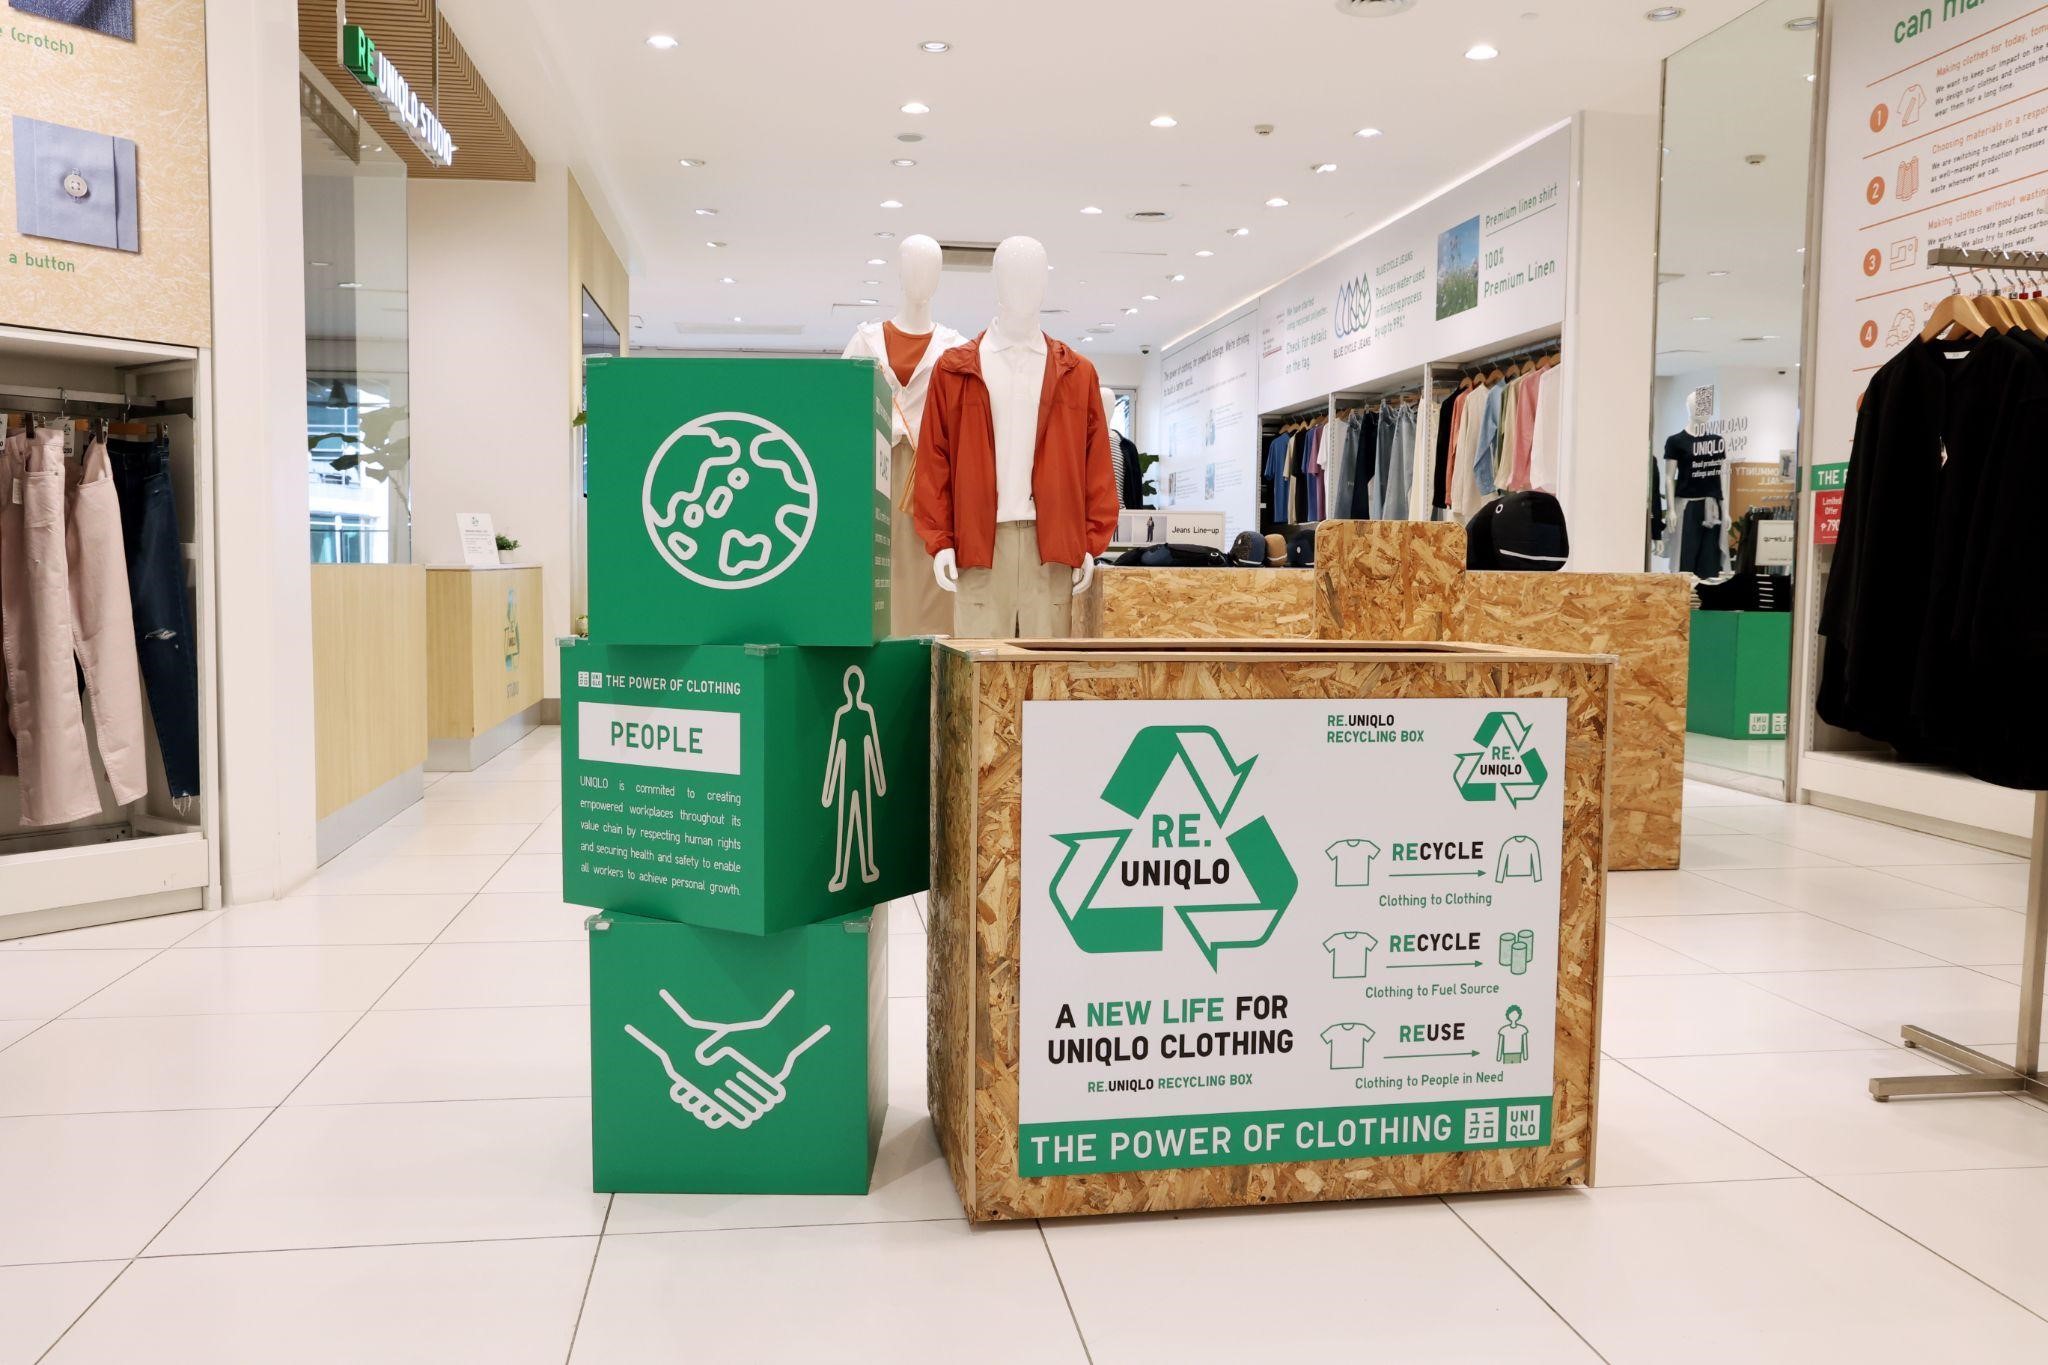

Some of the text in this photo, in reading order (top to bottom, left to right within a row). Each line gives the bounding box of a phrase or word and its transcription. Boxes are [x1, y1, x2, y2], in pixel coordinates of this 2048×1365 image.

[1894, 8, 1932, 44] can
[11, 27, 74, 55] (crotch)
[1936, 62, 1960, 77] Making
[1963, 49, 1988, 66] clothes
[1991, 44, 2002, 54] for
[1947, 79, 1960, 89] want
[1971, 69, 1984, 79] keep
[1987, 64, 1996, 72] our
[1999, 53, 2020, 67] impact
[2023, 50, 2030, 58] on
[2033, 44, 2043, 53] the
[1877, 110, 1882, 126] 1
[420, 102, 452, 166] STUDIO
[1932, 116, 2020, 154] Choosing materials in a
[1942, 159, 1951, 167] are
[1953, 149, 1980, 164] switching
[1991, 134, 2019, 149] materials
[2021, 128, 2034, 139] that
[2037, 125, 2048, 133] are
[1981, 150, 2012, 166] production
[2015, 138, 2045, 155] processes
[1872, 184, 1880, 199] 2
[1948, 175, 1975, 189] whenever
[1485, 183, 1558, 229] Premium linen shirt
[1928, 216, 1953, 230] Making
[1955, 208, 1983, 221] clothes
[1986, 197, 2016, 212] without
[1938, 234, 1951, 243] work
[1954, 230, 1967, 239] hard
[1977, 222, 1996, 232] create
[1998, 217, 2012, 227] good
[2015, 211, 2034, 223] places
[9, 252, 75, 272] a button
[1485, 246, 1504, 271] 100%
[1869, 255, 1877, 270] 3
[1484, 260, 1556, 298] Premium Linen
[1865, 326, 1873, 341] 4
[1694, 417, 1748, 437] DOWNLOAD
[1693, 436, 1747, 456] UNIQLO APP
[1818, 469, 1840, 485] THE
[1825, 507, 1838, 515] Offer
[1172, 526, 1220, 535] Jeans Line-up
[605, 674, 626, 688] THE
[629, 676, 666, 691] POWER
[670, 679, 684, 692] OF
[686, 681, 741, 695] CLOTHING
[1327, 714, 1395, 728] RE.UNIQLO
[611, 721, 703, 754] PEOPLE
[1327, 730, 1425, 743] RECYCLING BOX
[1492, 746, 1516, 760] RE.
[1480, 764, 1522, 777] UNIQLO
[580, 775, 609, 789] UNIQLO
[619, 780, 625, 791] is
[687, 787, 695, 799] to
[707, 791, 741, 807] creating
[580, 800, 741, 827] empowered workplaces throughout its
[580, 820, 741, 851] value chain by respecting human rights
[1151, 813, 1212, 848] RE.
[580, 841, 741, 873] and securing health and safety to enable
[1392, 841, 1484, 861] RECYCLE
[580, 862, 741, 896] all workers to achieve personal growth.
[1121, 858, 1230, 890] UNIQLO
[1379, 893, 1492, 909] Clothing to Clothing
[1389, 932, 1481, 953] RECYCLE
[1365, 983, 1500, 1000] Clothing to Fuel Source
[1055, 995, 1288, 1028] A NEW LIFE FOR
[1399, 1023, 1466, 1043] REUSE
[1048, 1029, 1293, 1066] UNIQLO CLOTHING
[1088, 1073, 1253, 1093] RE.UNIQLO RECYCLING BOX
[1355, 1071, 1504, 1090] Clothing to People in Need
[1510, 1110, 1535, 1122] UNI
[1030, 1114, 1452, 1164] THE POWER OF CLOTHING
[1510, 1124, 1536, 1138] QLO
